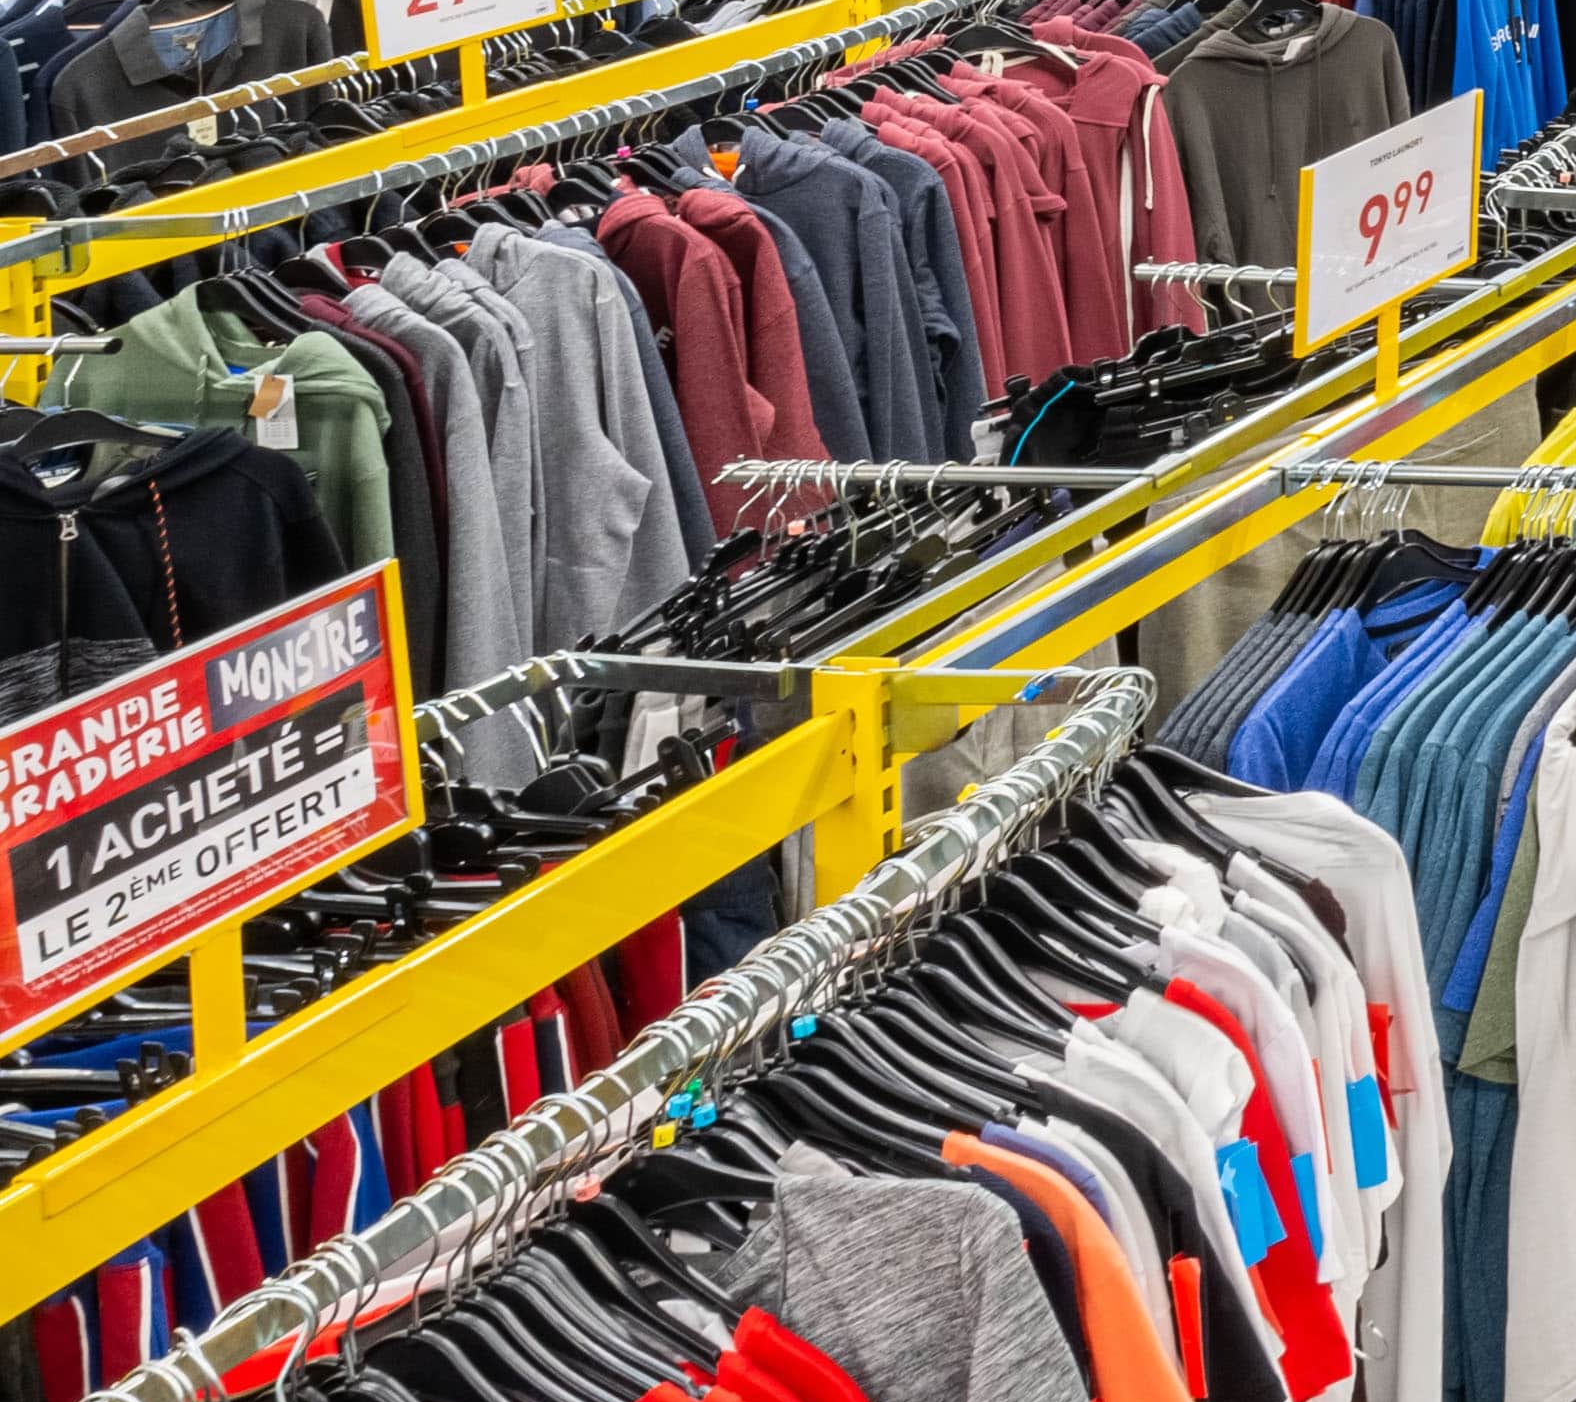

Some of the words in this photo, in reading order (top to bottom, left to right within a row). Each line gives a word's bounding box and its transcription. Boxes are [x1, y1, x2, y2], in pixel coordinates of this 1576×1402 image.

[1369, 151, 1394, 168] TOKYO
[1395, 137, 1424, 158] LAUNDRY
[219, 597, 371, 708] MONSTRE
[45, 845, 74, 891] 1
[94, 727, 302, 878] ACHETÉ
[35, 921, 92, 963] LE
[105, 862, 184, 929] 2ÈME
